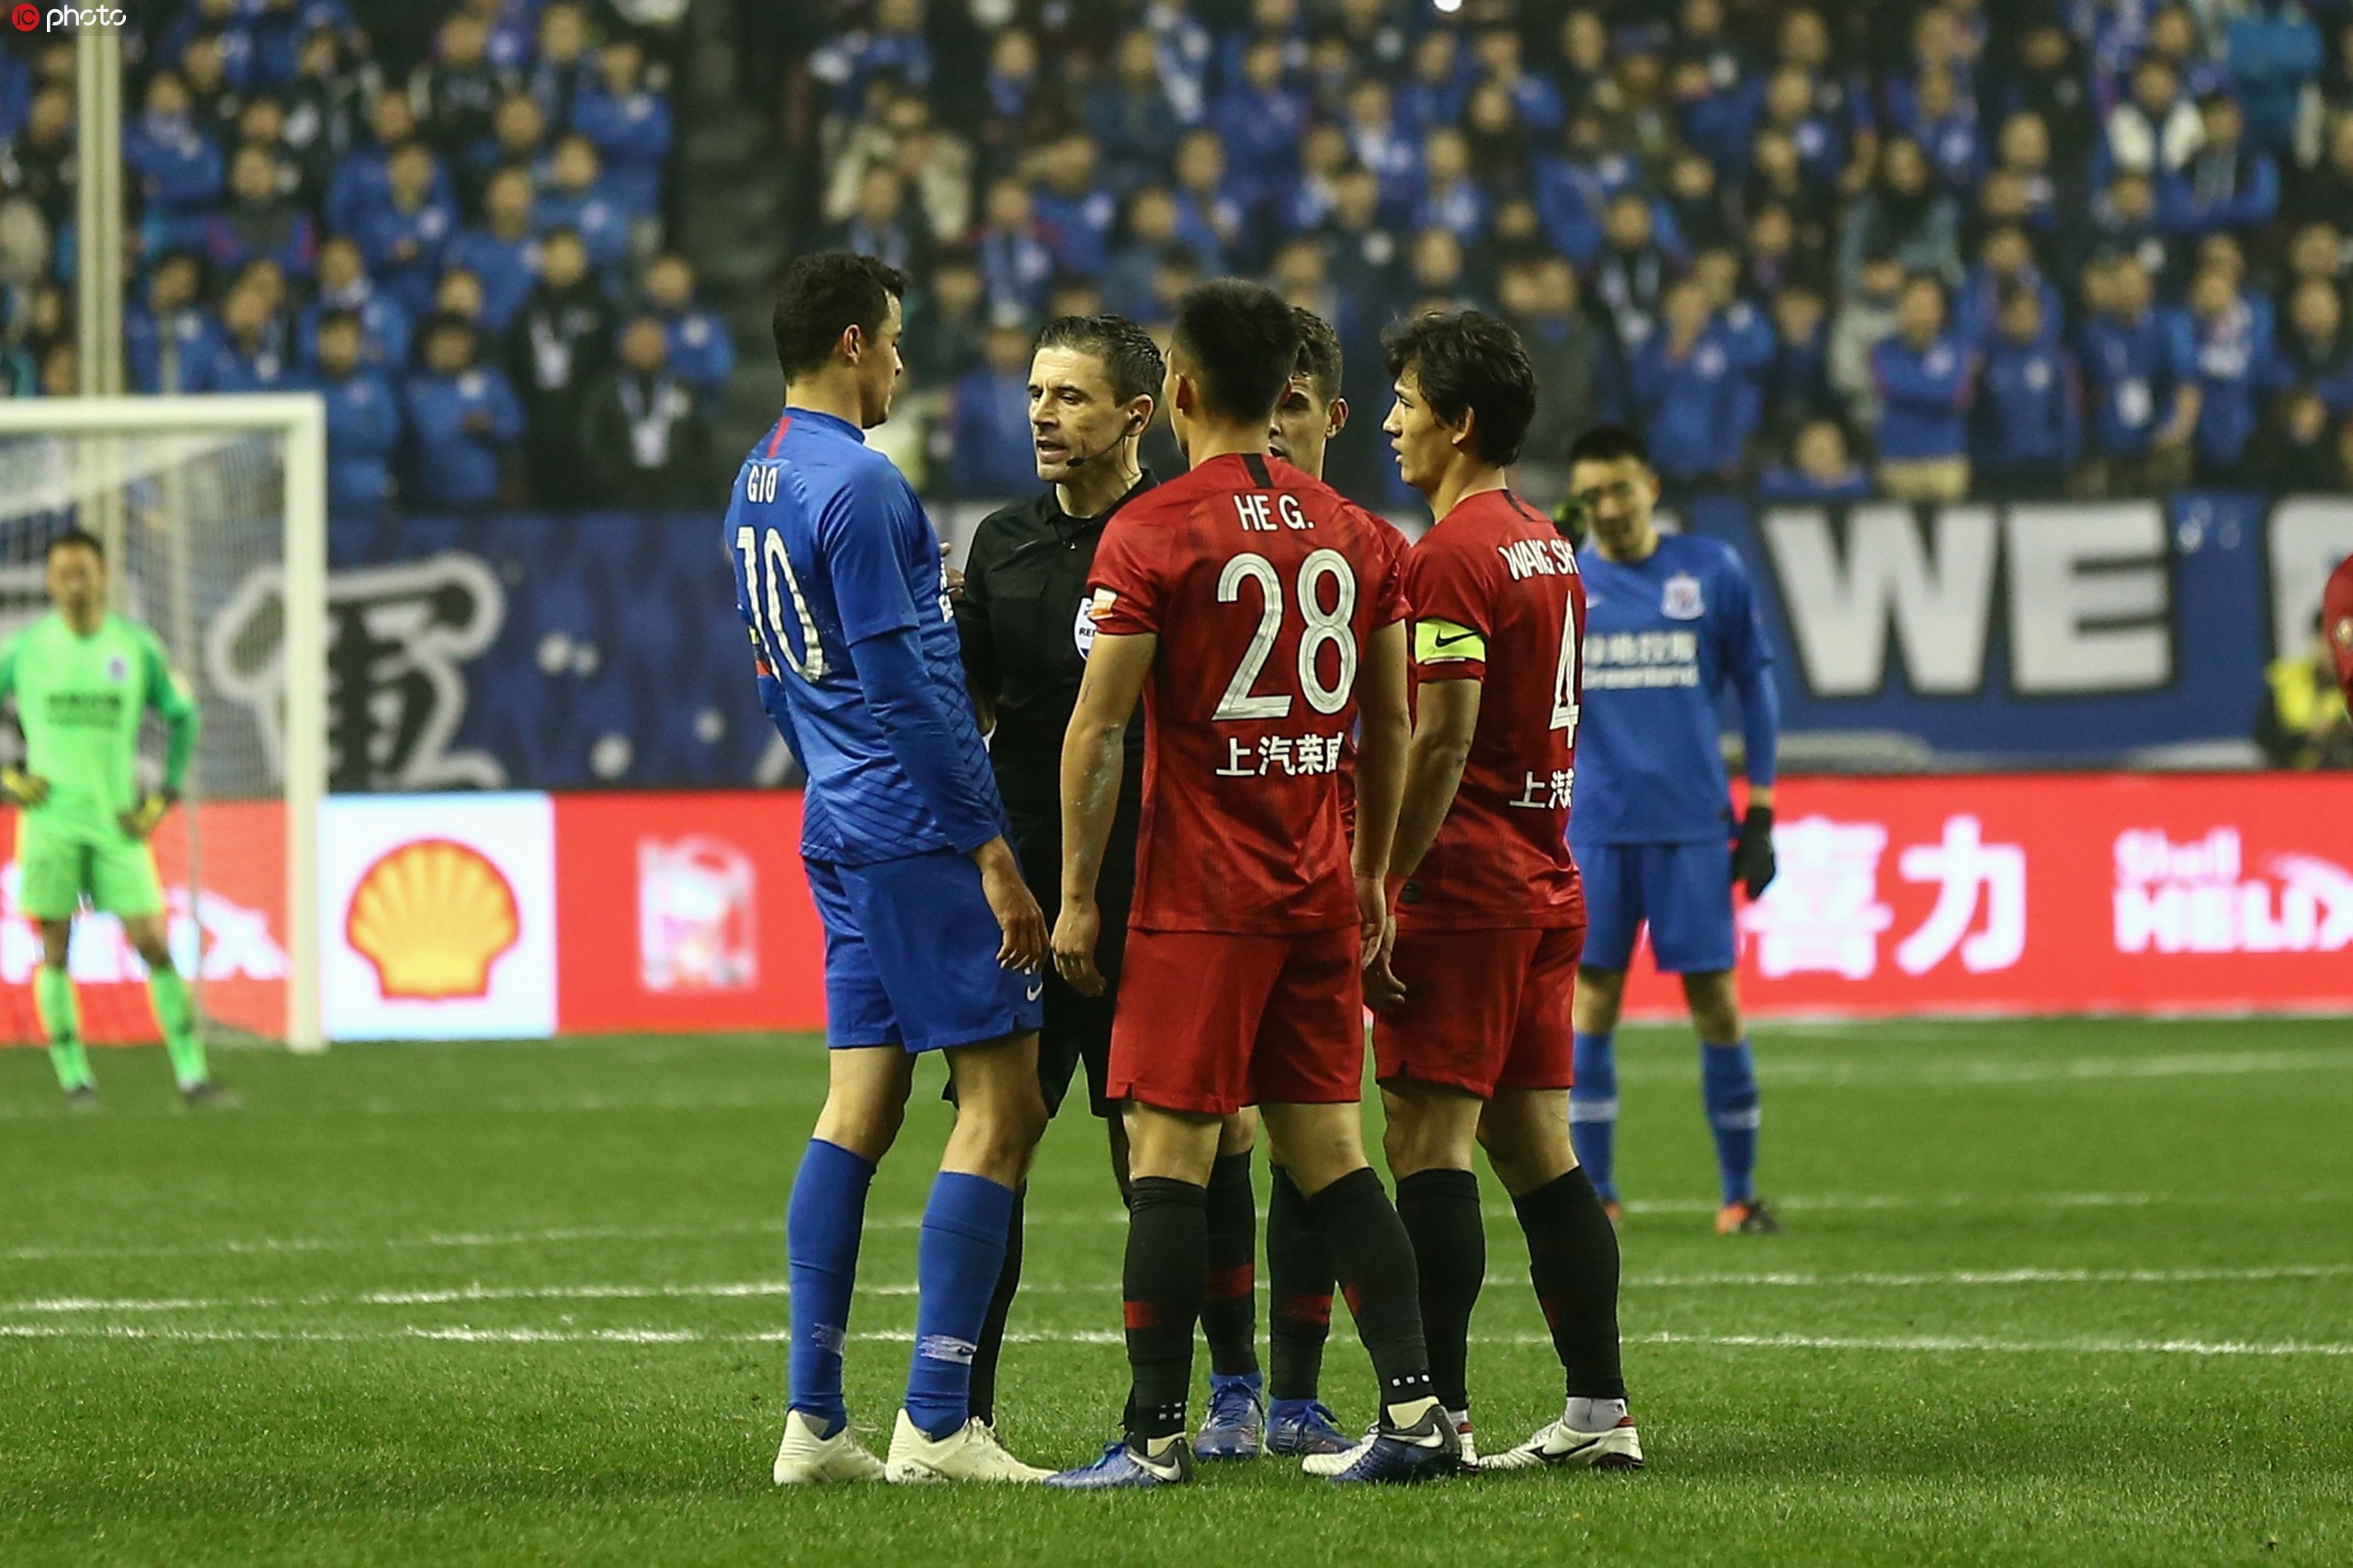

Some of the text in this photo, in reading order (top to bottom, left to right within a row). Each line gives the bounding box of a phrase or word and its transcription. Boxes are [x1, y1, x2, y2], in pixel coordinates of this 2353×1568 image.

[746, 464, 779, 504] GIO
[1233, 494, 1314, 531] HE G.
[736, 526, 824, 684] 10
[1211, 548, 1358, 722] 28
[1549, 589, 1581, 749] 4
[1761, 496, 2172, 697] WE
[1742, 813, 2027, 981] 喜力
